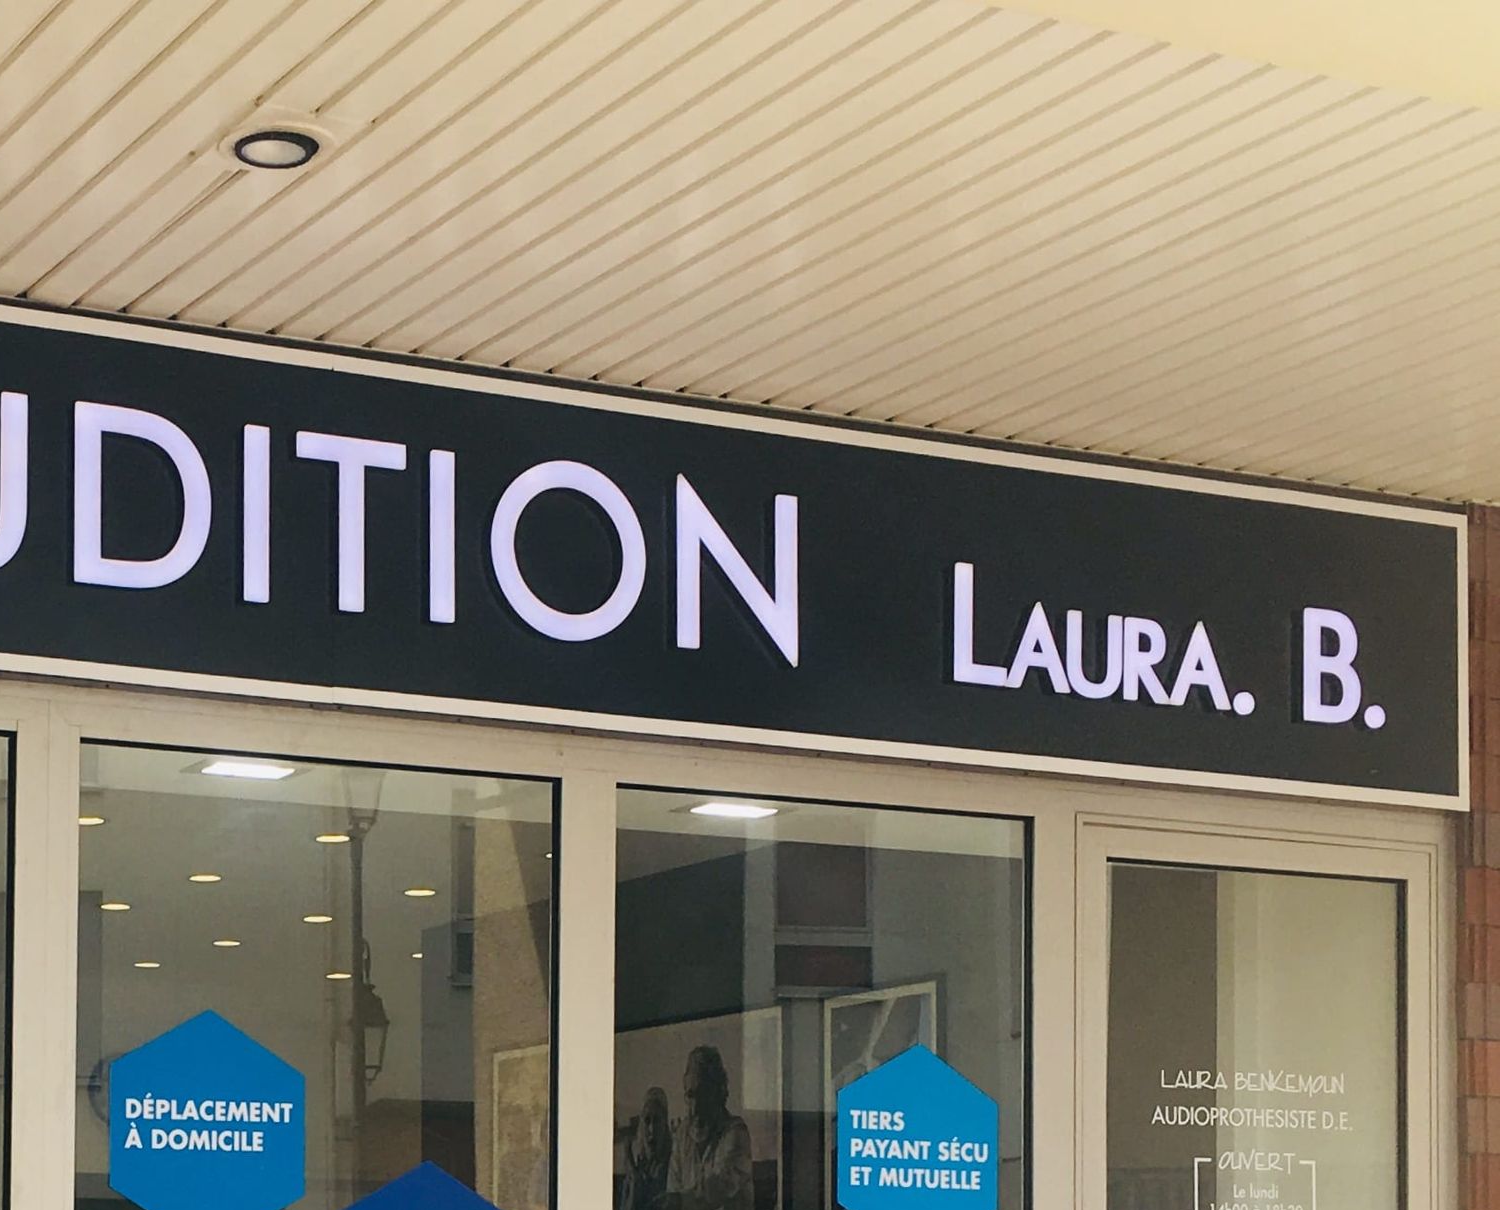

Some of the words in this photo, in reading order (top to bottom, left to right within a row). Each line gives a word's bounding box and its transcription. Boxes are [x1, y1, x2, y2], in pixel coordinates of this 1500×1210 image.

[953, 562, 1256, 716] LAURA.
[1303, 607, 1386, 729] B.
[1160, 1069, 1228, 1090] LAURA
[1235, 1071, 1345, 1097] BENKEMOUN
[125, 1092, 294, 1125] DÉPLACEMENT
[850, 1109, 905, 1131] TIERS
[1152, 1105, 1317, 1129] AUDIOPROTHESISTE
[1322, 1111, 1354, 1131] D.E.
[124, 1122, 143, 1150] À
[151, 1129, 264, 1152] DOMICILE
[850, 1138, 932, 1161] PAYANT
[938, 1136, 989, 1163] SÉCU
[1218, 1149, 1296, 1175] OUVERT
[850, 1166, 872, 1186] ET
[879, 1167, 981, 1190] MUTUELLE
[1233, 1184, 1246, 1199] Le
[1250, 1183, 1279, 1199] lundi
